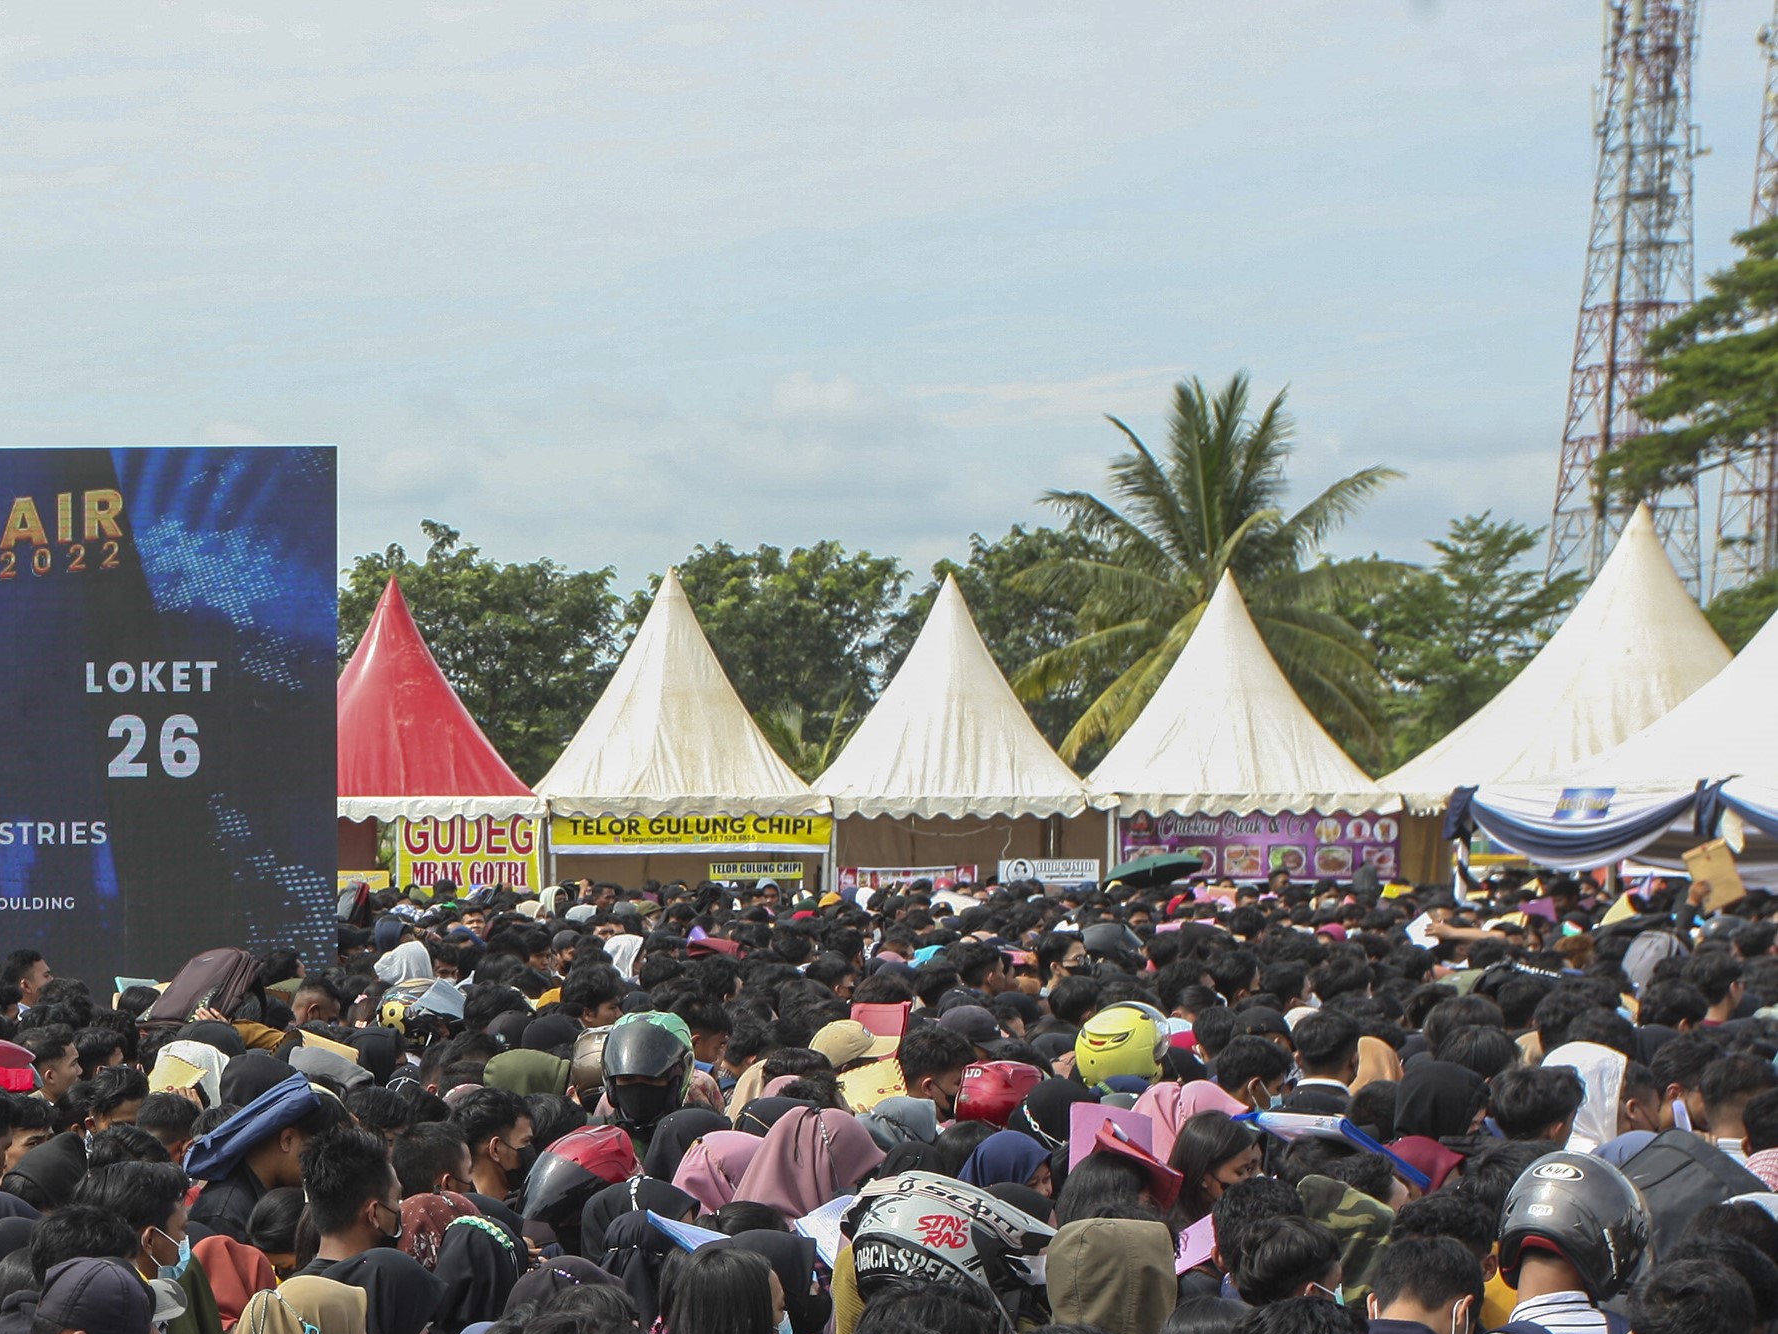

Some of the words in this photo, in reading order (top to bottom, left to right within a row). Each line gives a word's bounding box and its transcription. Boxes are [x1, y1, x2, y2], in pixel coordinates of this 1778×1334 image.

[0, 541, 121, 581] 2022
[85, 660, 219, 694] LOKET
[107, 713, 202, 779] 26
[404, 815, 534, 855] GUDEG
[569, 818, 641, 836] TELOR
[648, 818, 746, 836] GULUNG
[752, 816, 813, 836] CHIPI
[1157, 813, 1218, 840] Chicken
[1222, 812, 1262, 838] Steak
[411, 861, 464, 887] MBAK
[469, 861, 527, 887] GOTRI
[712, 863, 738, 874] TELOR
[739, 863, 775, 873] GULUNG
[776, 862, 802, 873] CHIPI
[964, 1068, 982, 1078] LTD
[919, 1183, 1020, 1235] SCOTT
[921, 1230, 969, 1250] RAD
